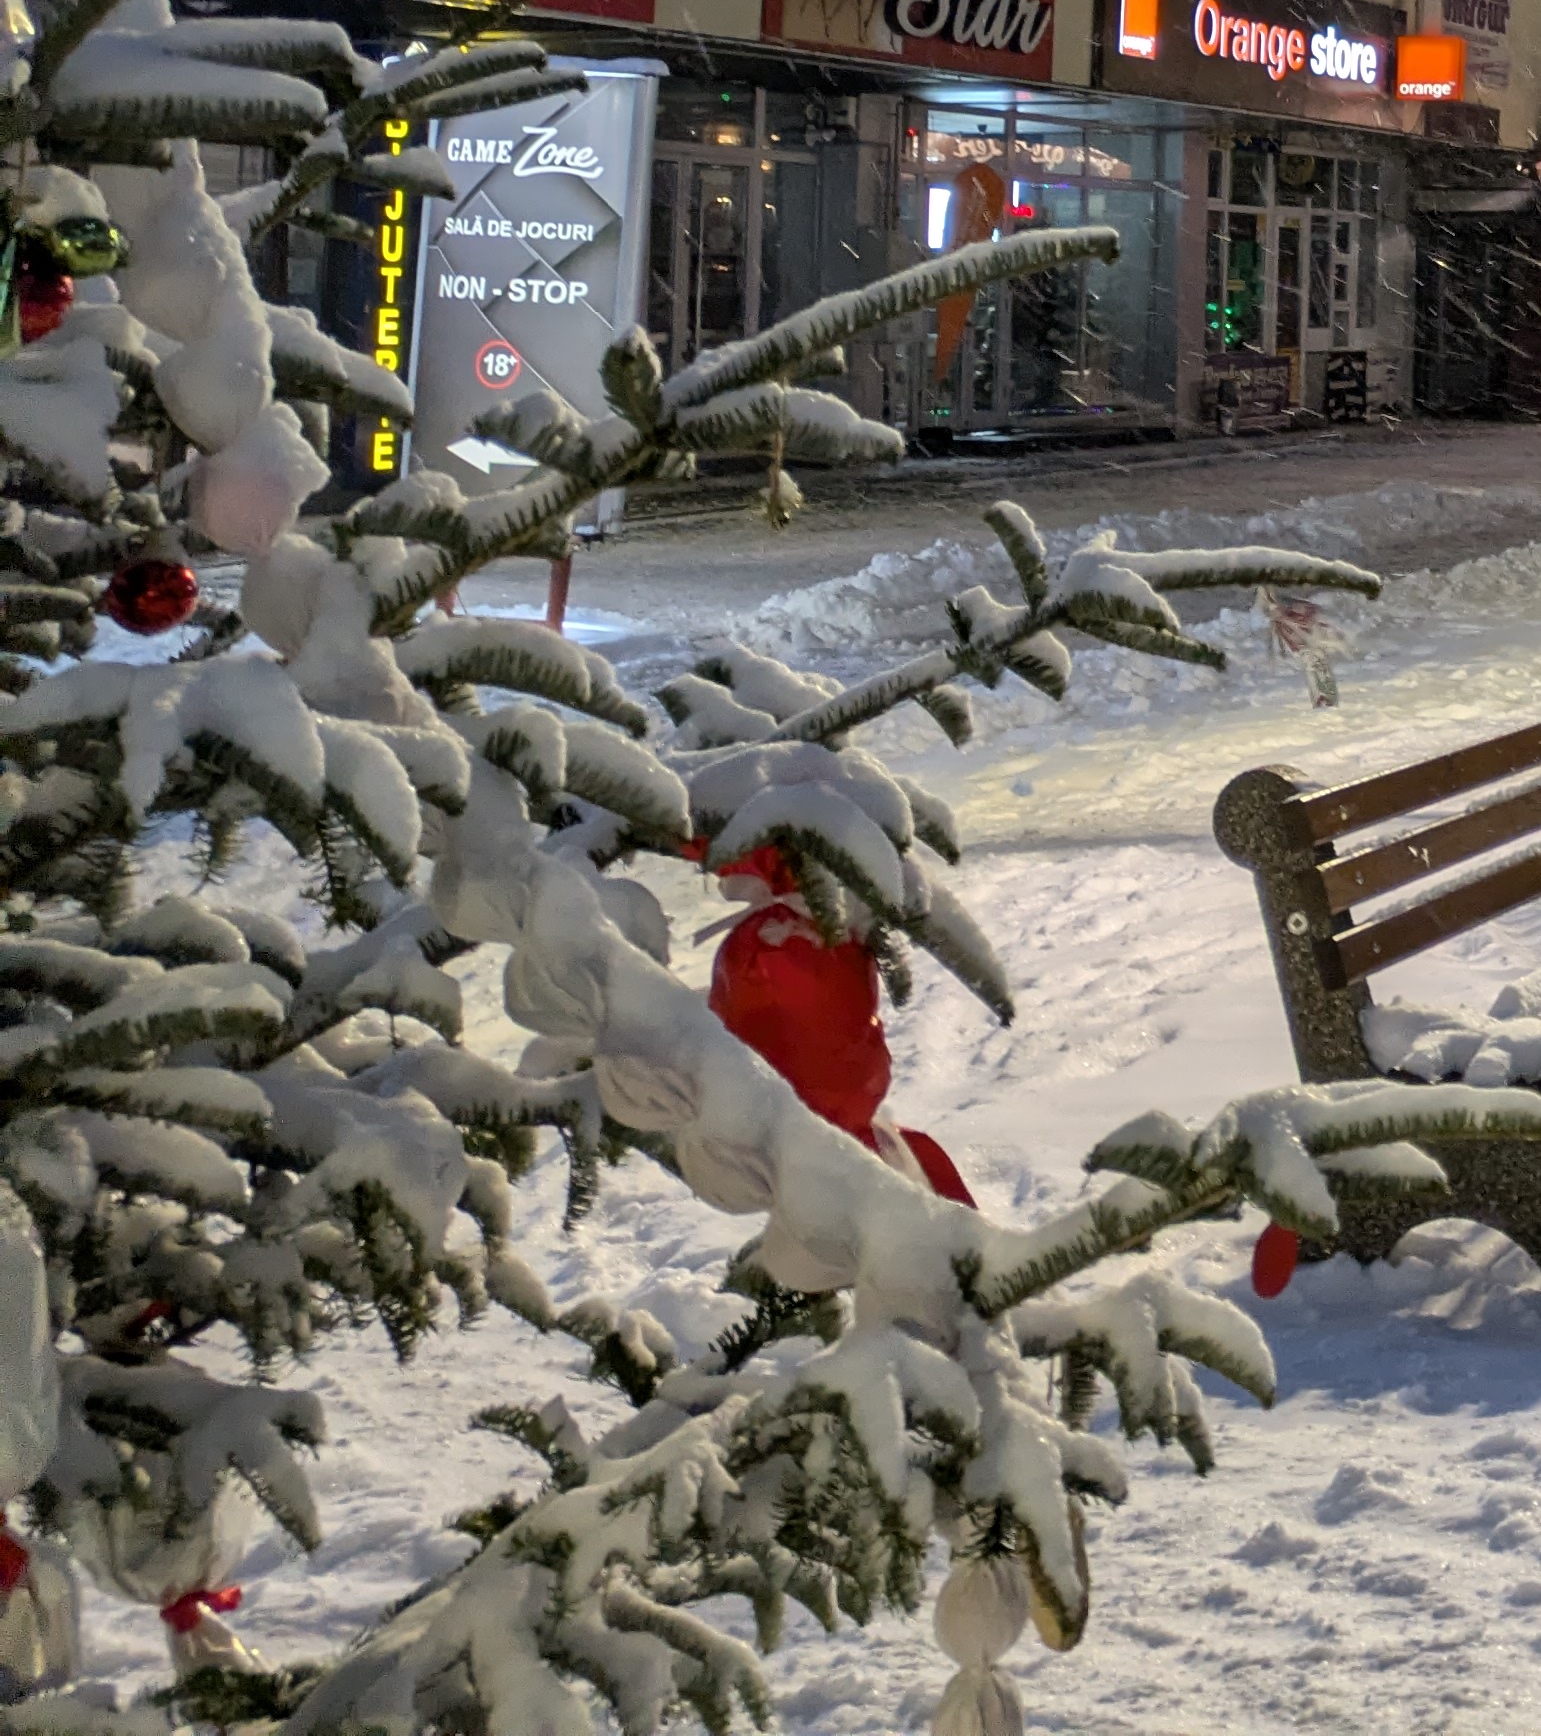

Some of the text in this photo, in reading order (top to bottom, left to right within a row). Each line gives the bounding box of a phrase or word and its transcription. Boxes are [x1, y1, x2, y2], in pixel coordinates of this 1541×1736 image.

[1310, 26, 1377, 84] store
[1399, 82, 1452, 99] orange
[447, 125, 604, 180] GAME Zone
[444, 215, 594, 242] SALĂ DE JOCURI
[438, 273, 487, 301] NON
[507, 277, 589, 305] STOP
